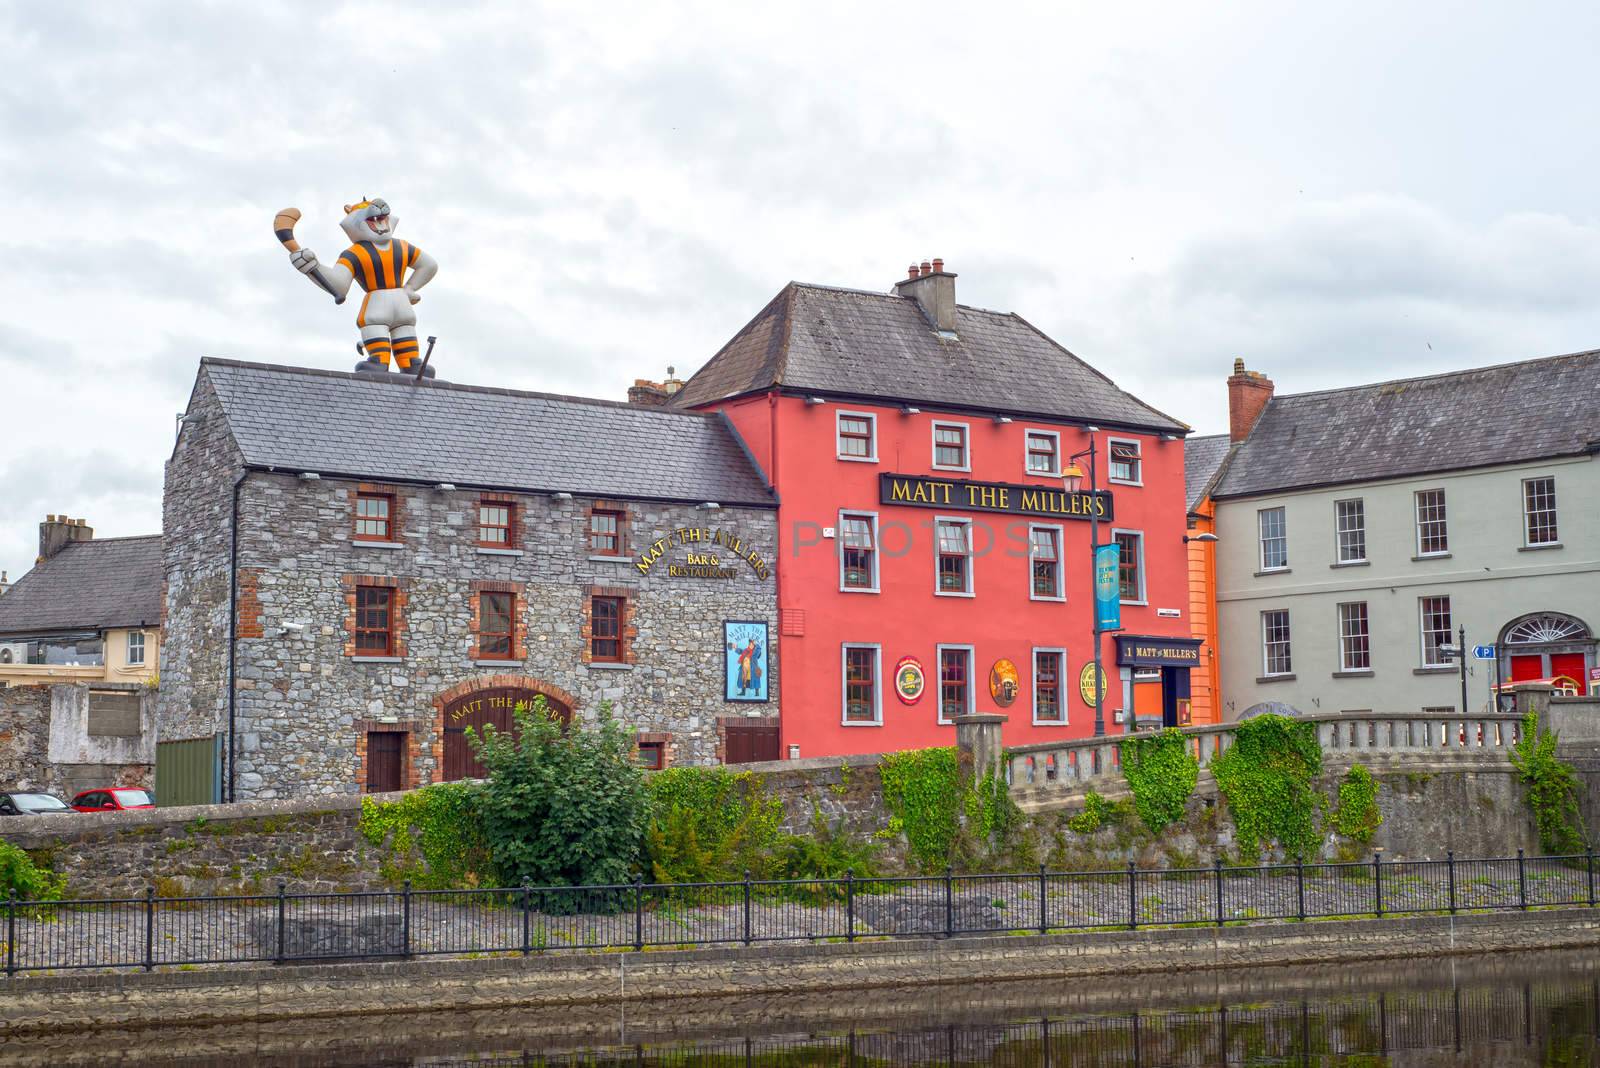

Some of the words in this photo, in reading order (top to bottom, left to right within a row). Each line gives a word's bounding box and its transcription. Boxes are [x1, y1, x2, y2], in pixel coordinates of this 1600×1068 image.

[891, 480, 954, 504] MATT
[965, 485, 1009, 508] THE
[1021, 490, 1104, 516] MILLERS
[635, 533, 673, 575] MATT
[678, 527, 711, 545] THE
[711, 528, 769, 580] MILLERS
[687, 553, 709, 565] BAR
[710, 554, 719, 566] &
[669, 565, 737, 580] RESTAURANT
[1136, 647, 1157, 657] MATT
[1163, 648, 1197, 659] MILLER'S
[1484, 648, 1490, 658] P
[450, 700, 482, 723] MATT
[488, 697, 513, 708] THE
